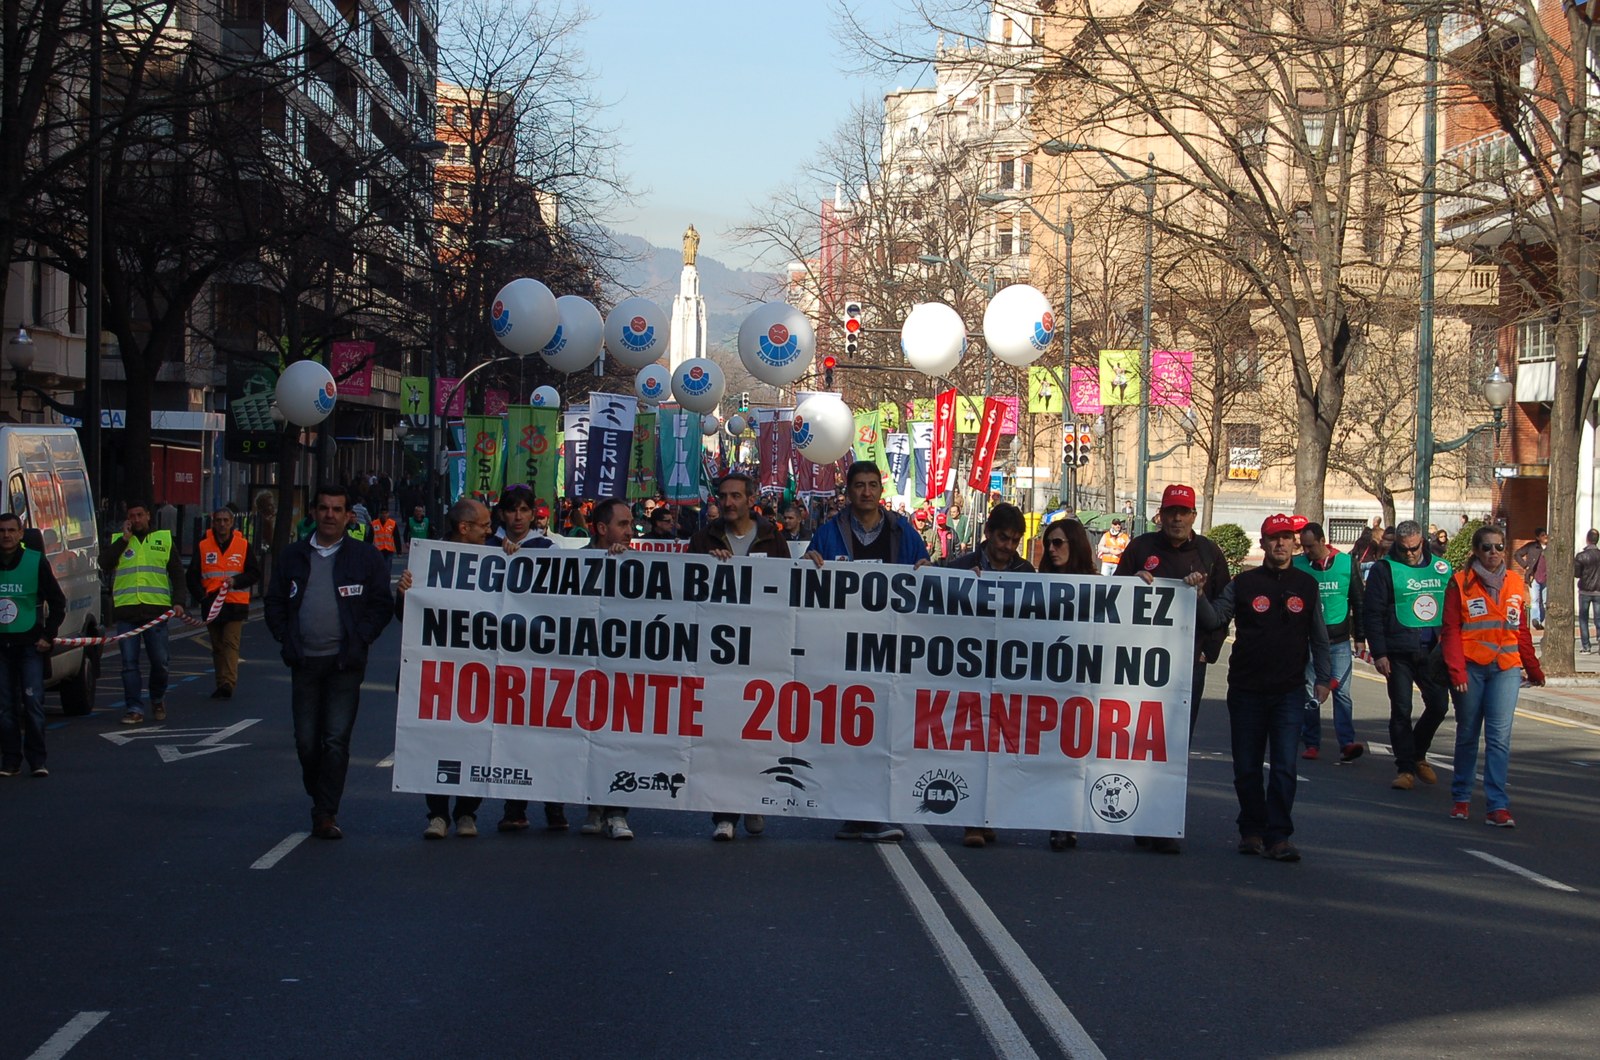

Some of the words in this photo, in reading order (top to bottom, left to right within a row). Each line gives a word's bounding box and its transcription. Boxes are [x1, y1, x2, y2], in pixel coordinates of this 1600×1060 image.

[756, 349, 801, 367] ERTZAINTZA
[574, 442, 588, 496] ERNE
[598, 431, 618, 497] ERNE
[668, 414, 691, 487] ELA
[427, 549, 672, 601] NEGOZIAZIOA
[683, 562, 753, 605] BAI
[790, 568, 1122, 625] INPOSAKETARIK
[1132, 586, 1175, 627] EZ
[422, 607, 699, 662] NEGOCIACIÓN
[710, 624, 752, 666] SI
[845, 631, 1103, 685] IMPOSICIÓN
[1113, 645, 1171, 688] NO
[418, 660, 705, 737] HORIZONTE
[741, 679, 875, 747] 2016
[913, 688, 1168, 762] KANPORA
[470, 765, 533, 781] EUSPEL
[912, 769, 970, 800] ERTZAINTZA
[927, 789, 956, 802] ELA
[761, 797, 778, 805] Er.
[786, 798, 799, 806] N.
[806, 800, 818, 808] E.
